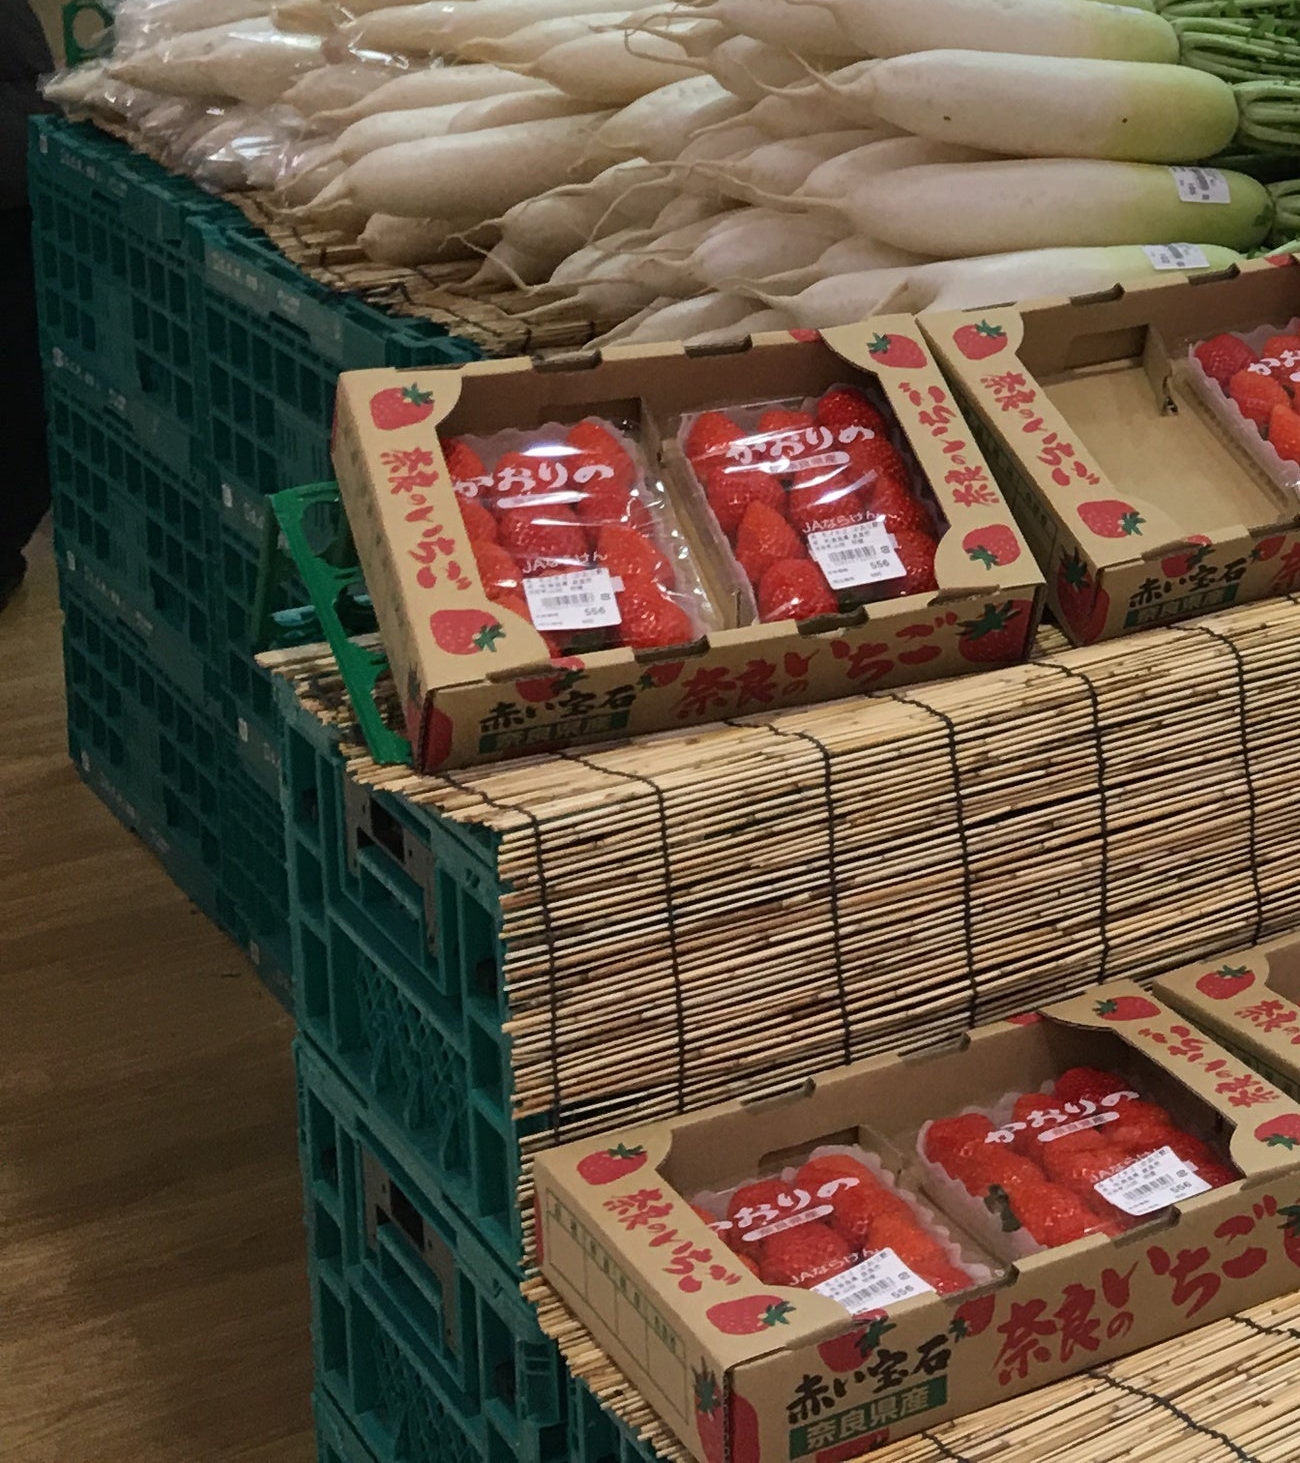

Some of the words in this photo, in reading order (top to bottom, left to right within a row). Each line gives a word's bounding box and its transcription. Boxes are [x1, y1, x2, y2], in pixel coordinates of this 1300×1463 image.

[980, 368, 1101, 488] 奈良のいちご
[379, 446, 474, 594] 奈良のいちご
[869, 558, 891, 570] 556
[1128, 556, 1247, 608] 赤い宝石
[480, 684, 637, 734] 赤い宝石
[673, 617, 955, 721] 奈良のいちご
[984, 1090, 1141, 1145] かおりの
[1168, 1180, 1193, 1193] 556
[605, 1189, 744, 1295] 奈良のいちご
[786, 1334, 955, 1424] 赤い宝石
[991, 1192, 1280, 1388] 奈良のいちご
[889, 1283, 914, 1302] 556
[803, 1383, 933, 1451] 奈良県産
